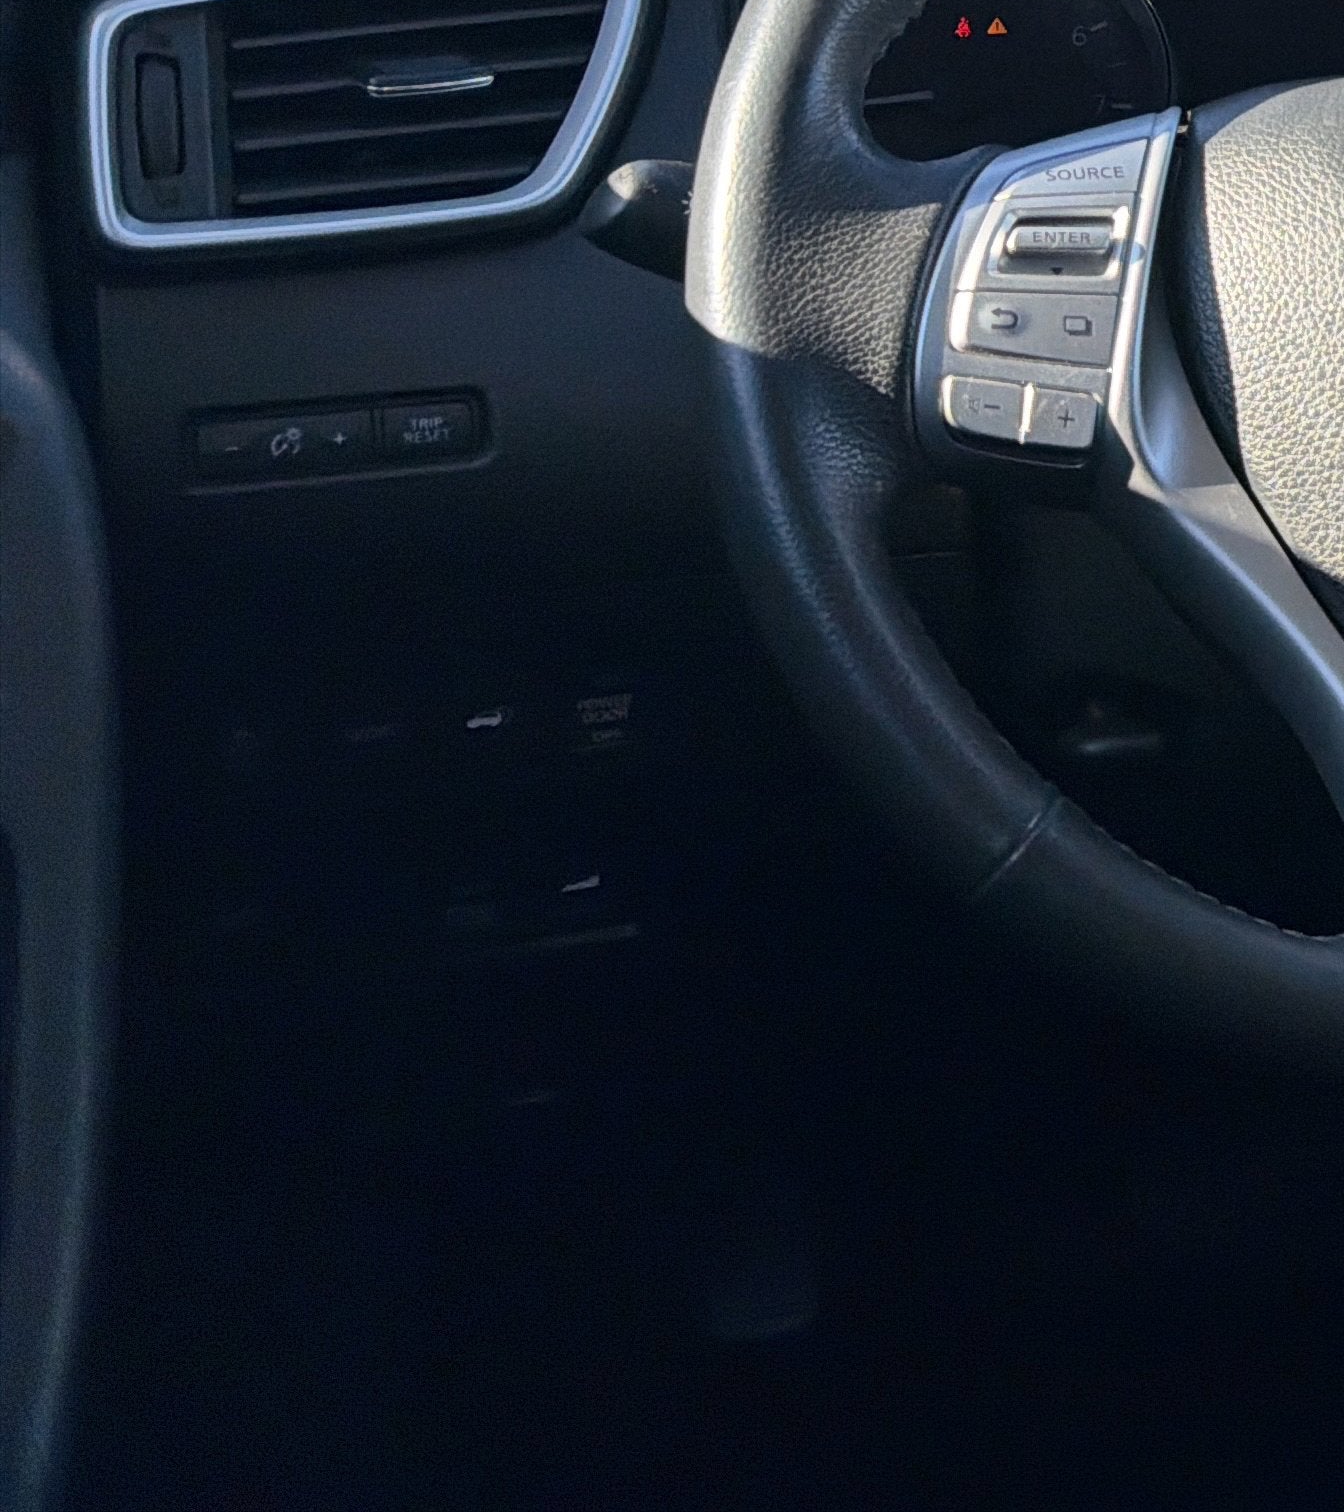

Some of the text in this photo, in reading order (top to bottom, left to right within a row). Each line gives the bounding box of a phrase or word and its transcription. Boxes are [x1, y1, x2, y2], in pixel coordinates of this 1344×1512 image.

[1072, 25, 1087, 47] 6
[1045, 166, 1125, 182] SOURCE
[1032, 231, 1091, 244] ENTER
[411, 417, 443, 430] TRIP
